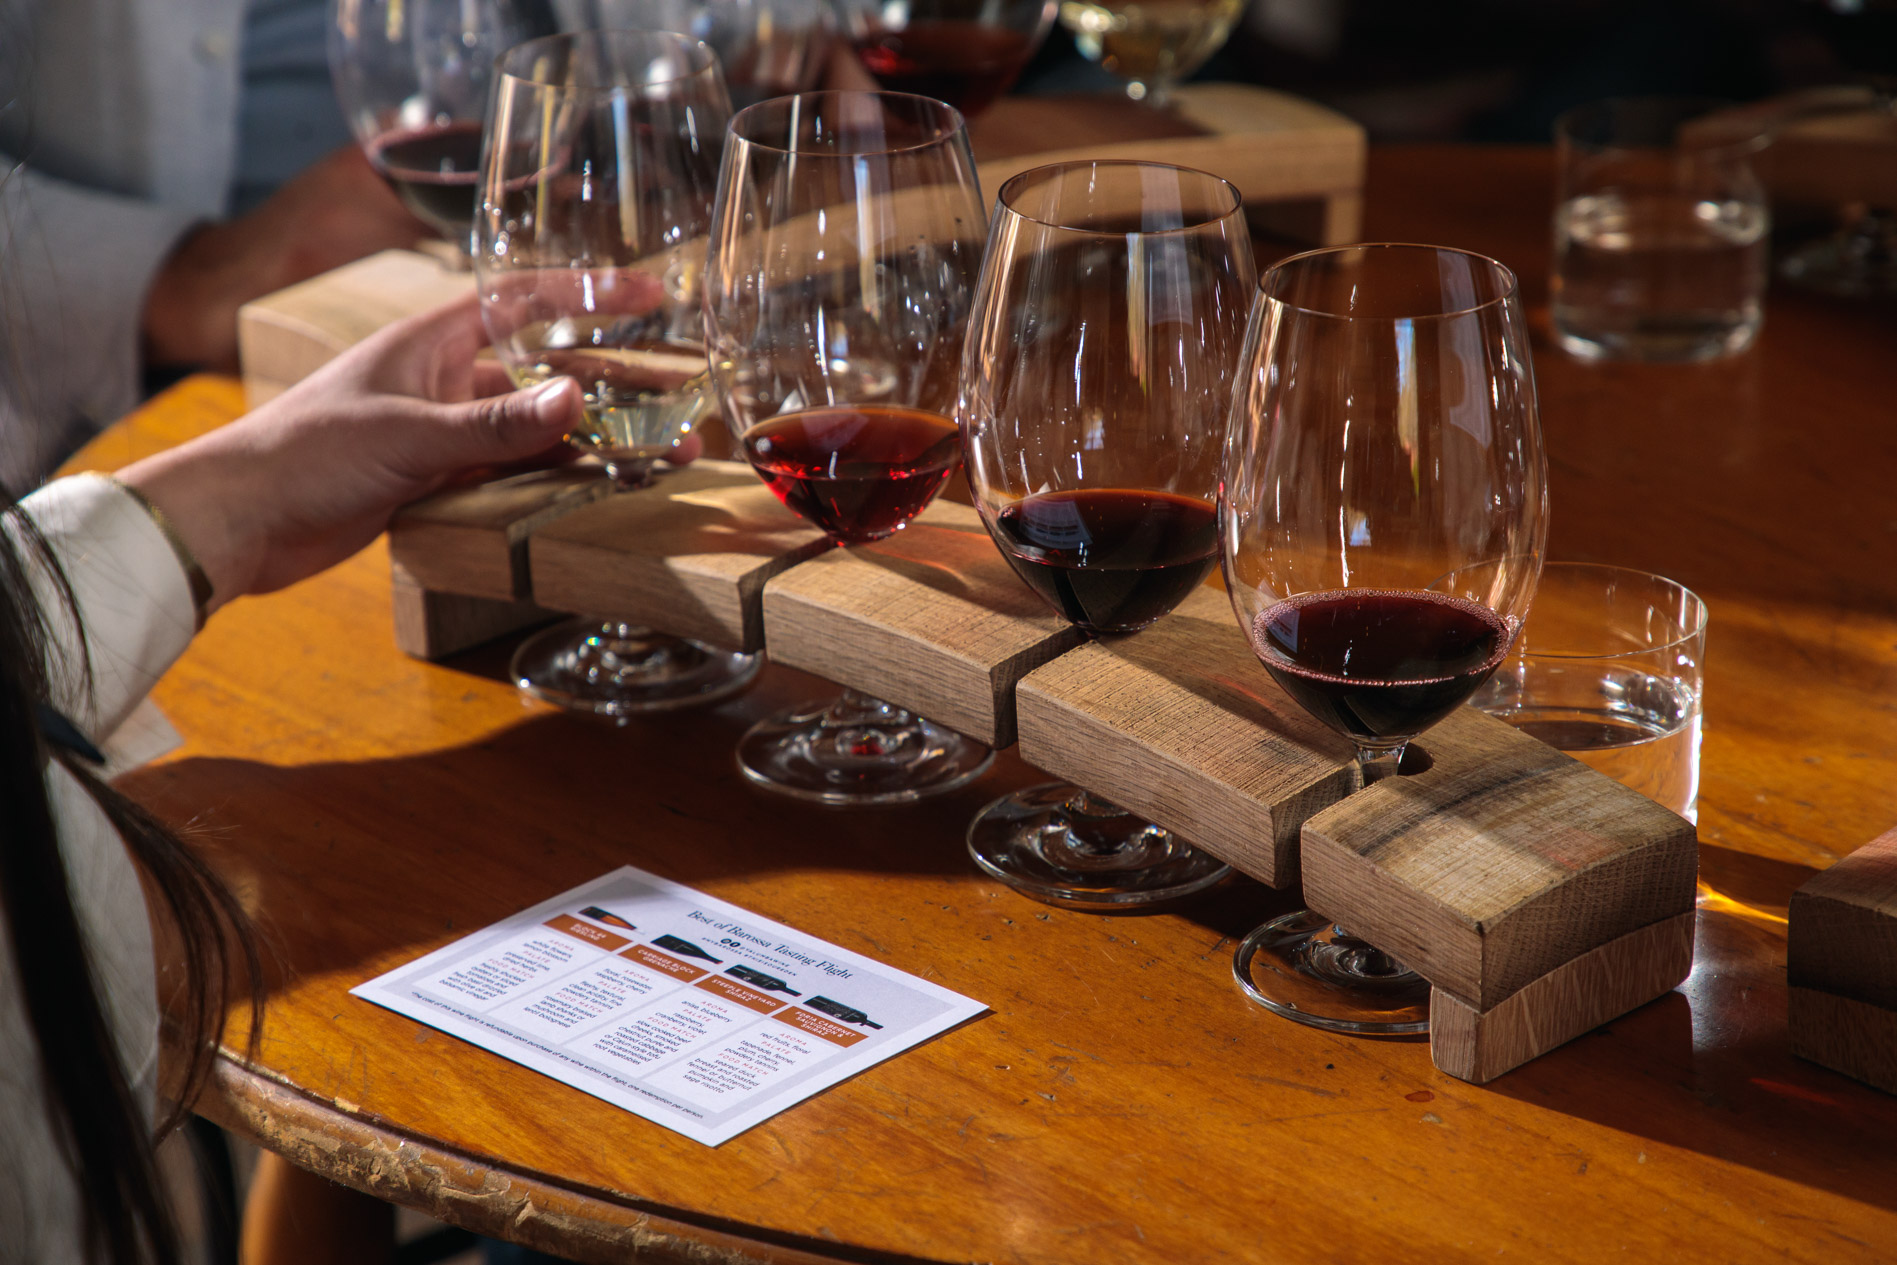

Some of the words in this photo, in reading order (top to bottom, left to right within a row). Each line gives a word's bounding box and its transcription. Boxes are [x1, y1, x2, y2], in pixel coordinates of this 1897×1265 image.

[548, 939, 575, 951] AROMA
[685, 910, 719, 924] Best
[711, 920, 733, 930] of
[725, 926, 777, 947] Barossa
[766, 943, 821, 966] Tasting
[810, 960, 858, 980] Flight
[521, 950, 551, 963] PALATE
[635, 949, 673, 964] CARRIAGE
[669, 963, 697, 974] BLOCK
[640, 956, 680, 972] GRENACHE
[487, 958, 510, 968] FOOD
[509, 967, 535, 978] MATCH
[623, 969, 651, 981] AROMA
[567, 983, 588, 991] clean
[597, 981, 627, 993] PALATE
[623, 984, 648, 994] cherry
[710, 979, 742, 992] STEEPLE
[739, 991, 778, 1006] VINEYARD
[723, 989, 752, 1001] SHIRAZ
[543, 995, 574, 1008] rosemary
[554, 992, 577, 1002] FOOD
[576, 1001, 604, 1013] MATCH
[560, 987, 591, 1000] powdery
[588, 998, 615, 1009] tannins
[531, 1003, 566, 1018] mushroom
[539, 1000, 558, 1008] lamb
[554, 1006, 578, 1016] shanks
[681, 1009, 712, 1021] PALATE
[698, 1008, 733, 1022] blueberry
[699, 1001, 729, 1013] AROMA
[536, 1013, 572, 1028] bolognese
[646, 1017, 670, 1027] FOOD
[669, 1026, 698, 1038] MATCH
[794, 1016, 838, 1034] SAUVIGNON
[816, 1020, 857, 1037] CABERNET
[616, 1026, 647, 1039] chestnut
[649, 1026, 676, 1037] cooked
[673, 1035, 691, 1043] beef
[685, 1025, 708, 1034] violet
[799, 1024, 828, 1035] SHIRAZ
[613, 1031, 640, 1042] roasted
[636, 1041, 667, 1054] cabbage
[653, 1034, 681, 1046] smoked
[778, 1033, 808, 1045] AROMA
[597, 1038, 615, 1046] with
[611, 1044, 652, 1062] caramelised
[610, 1037, 649, 1053] Cajun-style
[645, 1051, 663, 1059] tofu
[760, 1041, 791, 1054] PALATE
[791, 1045, 811, 1054] floral
[482, 1022, 515, 1036] refundable
[525, 1041, 554, 1053] purchase
[581, 1065, 604, 1074] within
[637, 1089, 674, 1105] redemption
[604, 1049, 642, 1065] vegetables
[716, 1053, 741, 1063] FOOD
[741, 1063, 770, 1075] MATCH
[723, 1047, 755, 1061] powdery
[753, 1060, 780, 1071] tannins
[685, 1062, 710, 1072] fennel
[717, 1075, 753, 1090] butternut
[693, 1058, 719, 1069] breast
[716, 1067, 733, 1075] and
[730, 1073, 760, 1086] roasted
[713, 1059, 739, 1070] seared
[737, 1069, 757, 1078] duck
[681, 1074, 701, 1083] sage
[698, 1081, 726, 1093] risotto
[687, 1070, 721, 1084] pumpkin
[718, 1082, 735, 1090] and
